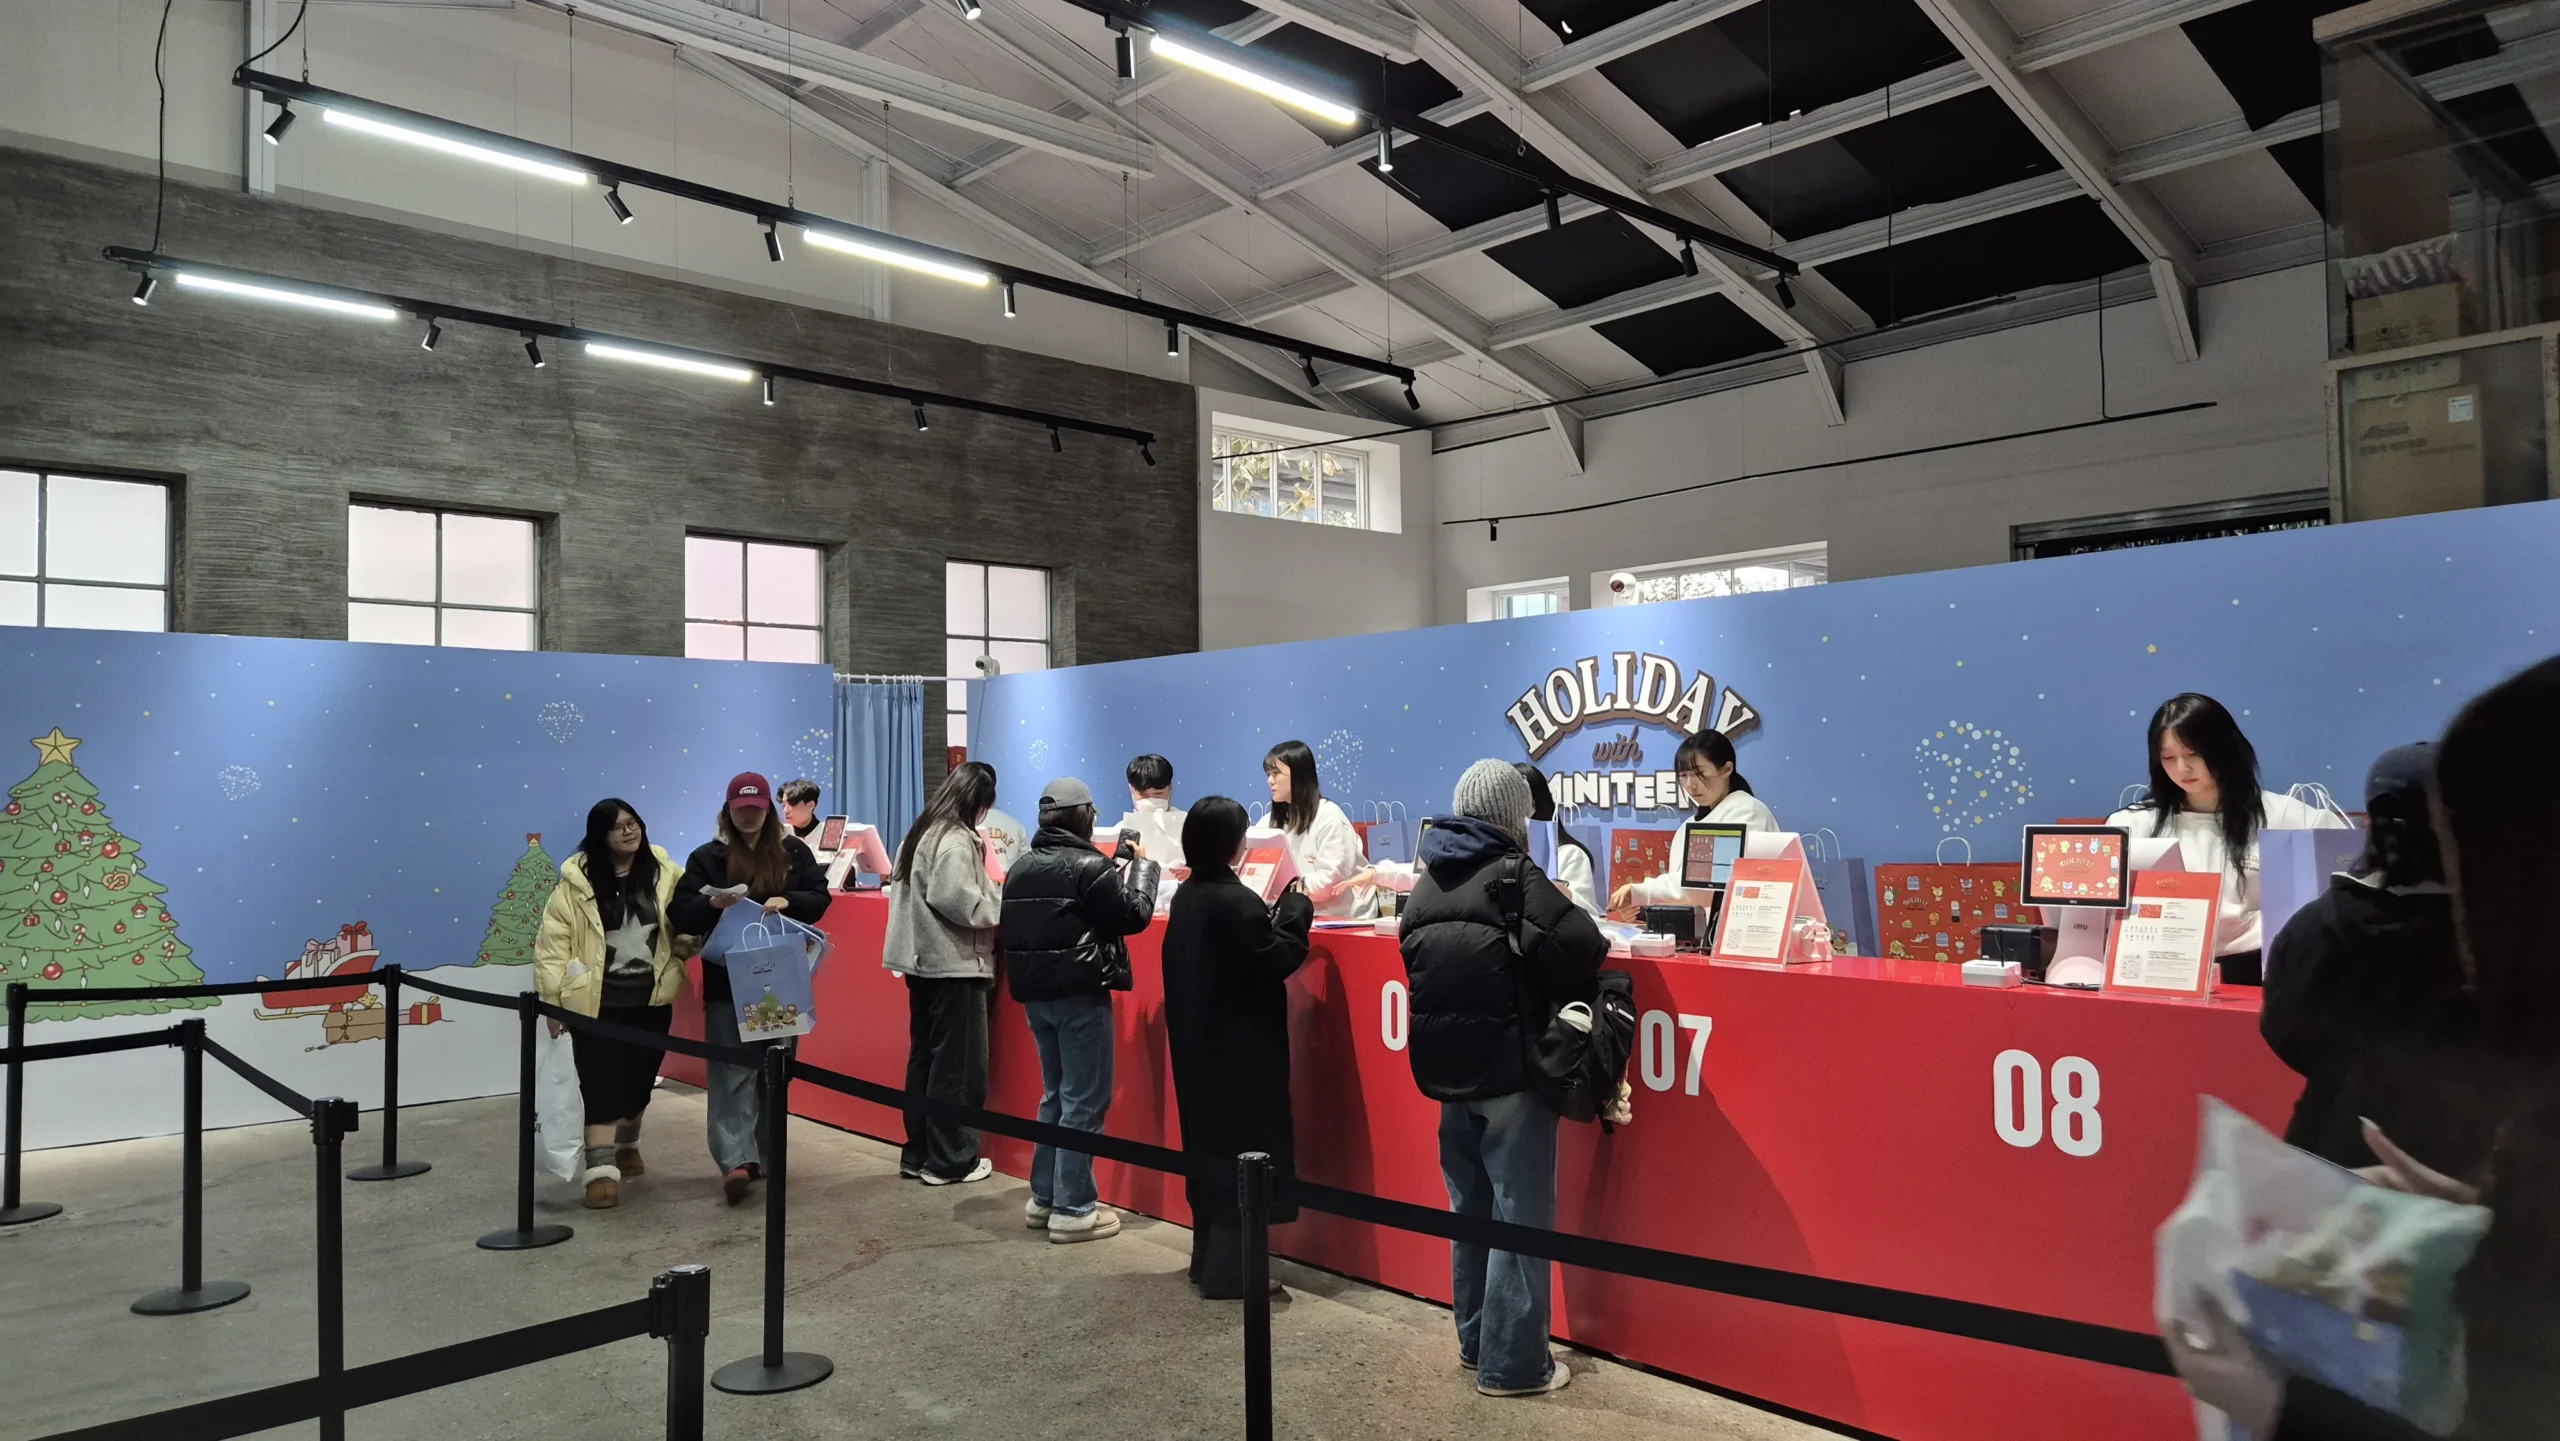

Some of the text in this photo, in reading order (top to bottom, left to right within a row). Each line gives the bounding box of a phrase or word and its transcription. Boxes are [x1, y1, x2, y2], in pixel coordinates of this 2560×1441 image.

[1505, 651, 1758, 760] HOLIDAY
[1592, 724, 1643, 762] with
[1381, 980, 1408, 1051] 0
[1640, 1009, 1712, 1097] 07
[1993, 1049, 2102, 1157] 08
